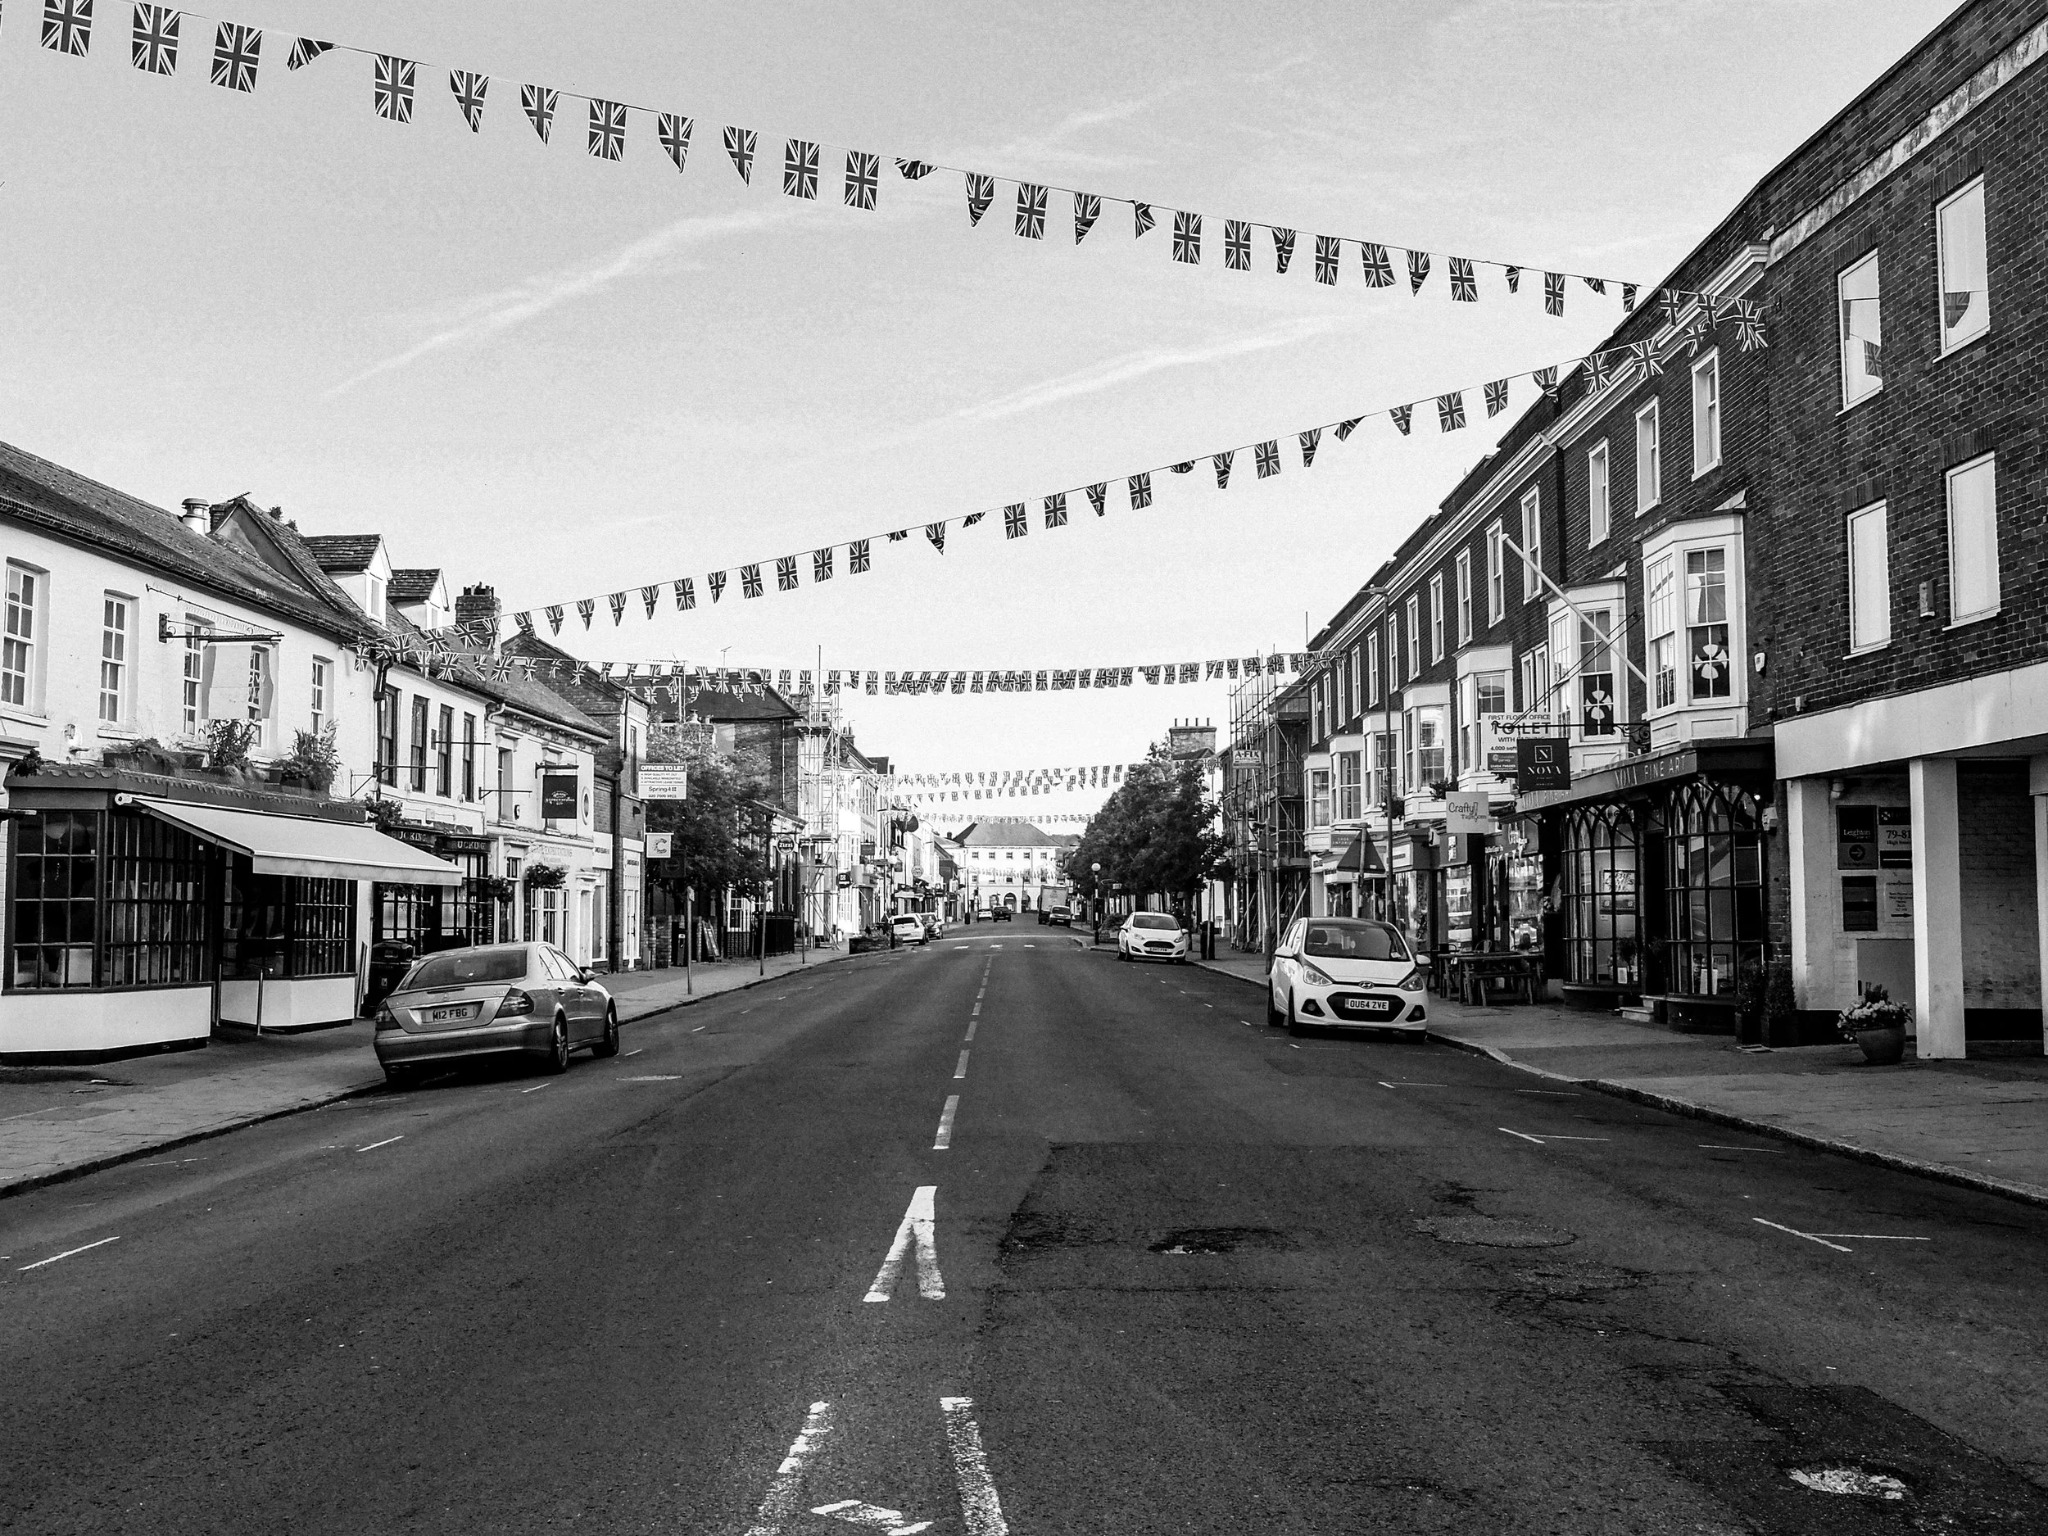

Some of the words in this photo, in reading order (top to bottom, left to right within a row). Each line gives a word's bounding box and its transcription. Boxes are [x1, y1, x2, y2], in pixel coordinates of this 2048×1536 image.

[1522, 722, 1551, 735] LET
[1527, 765, 1562, 775] NOVA
[1614, 765, 1638, 790] NOVA
[1644, 760, 1665, 781] FINE
[1669, 754, 1686, 773] ART
[1448, 802, 1475, 815] Crafty
[1372, 1001, 1388, 1010] ZVE
[449, 1008, 468, 1018] FBG
